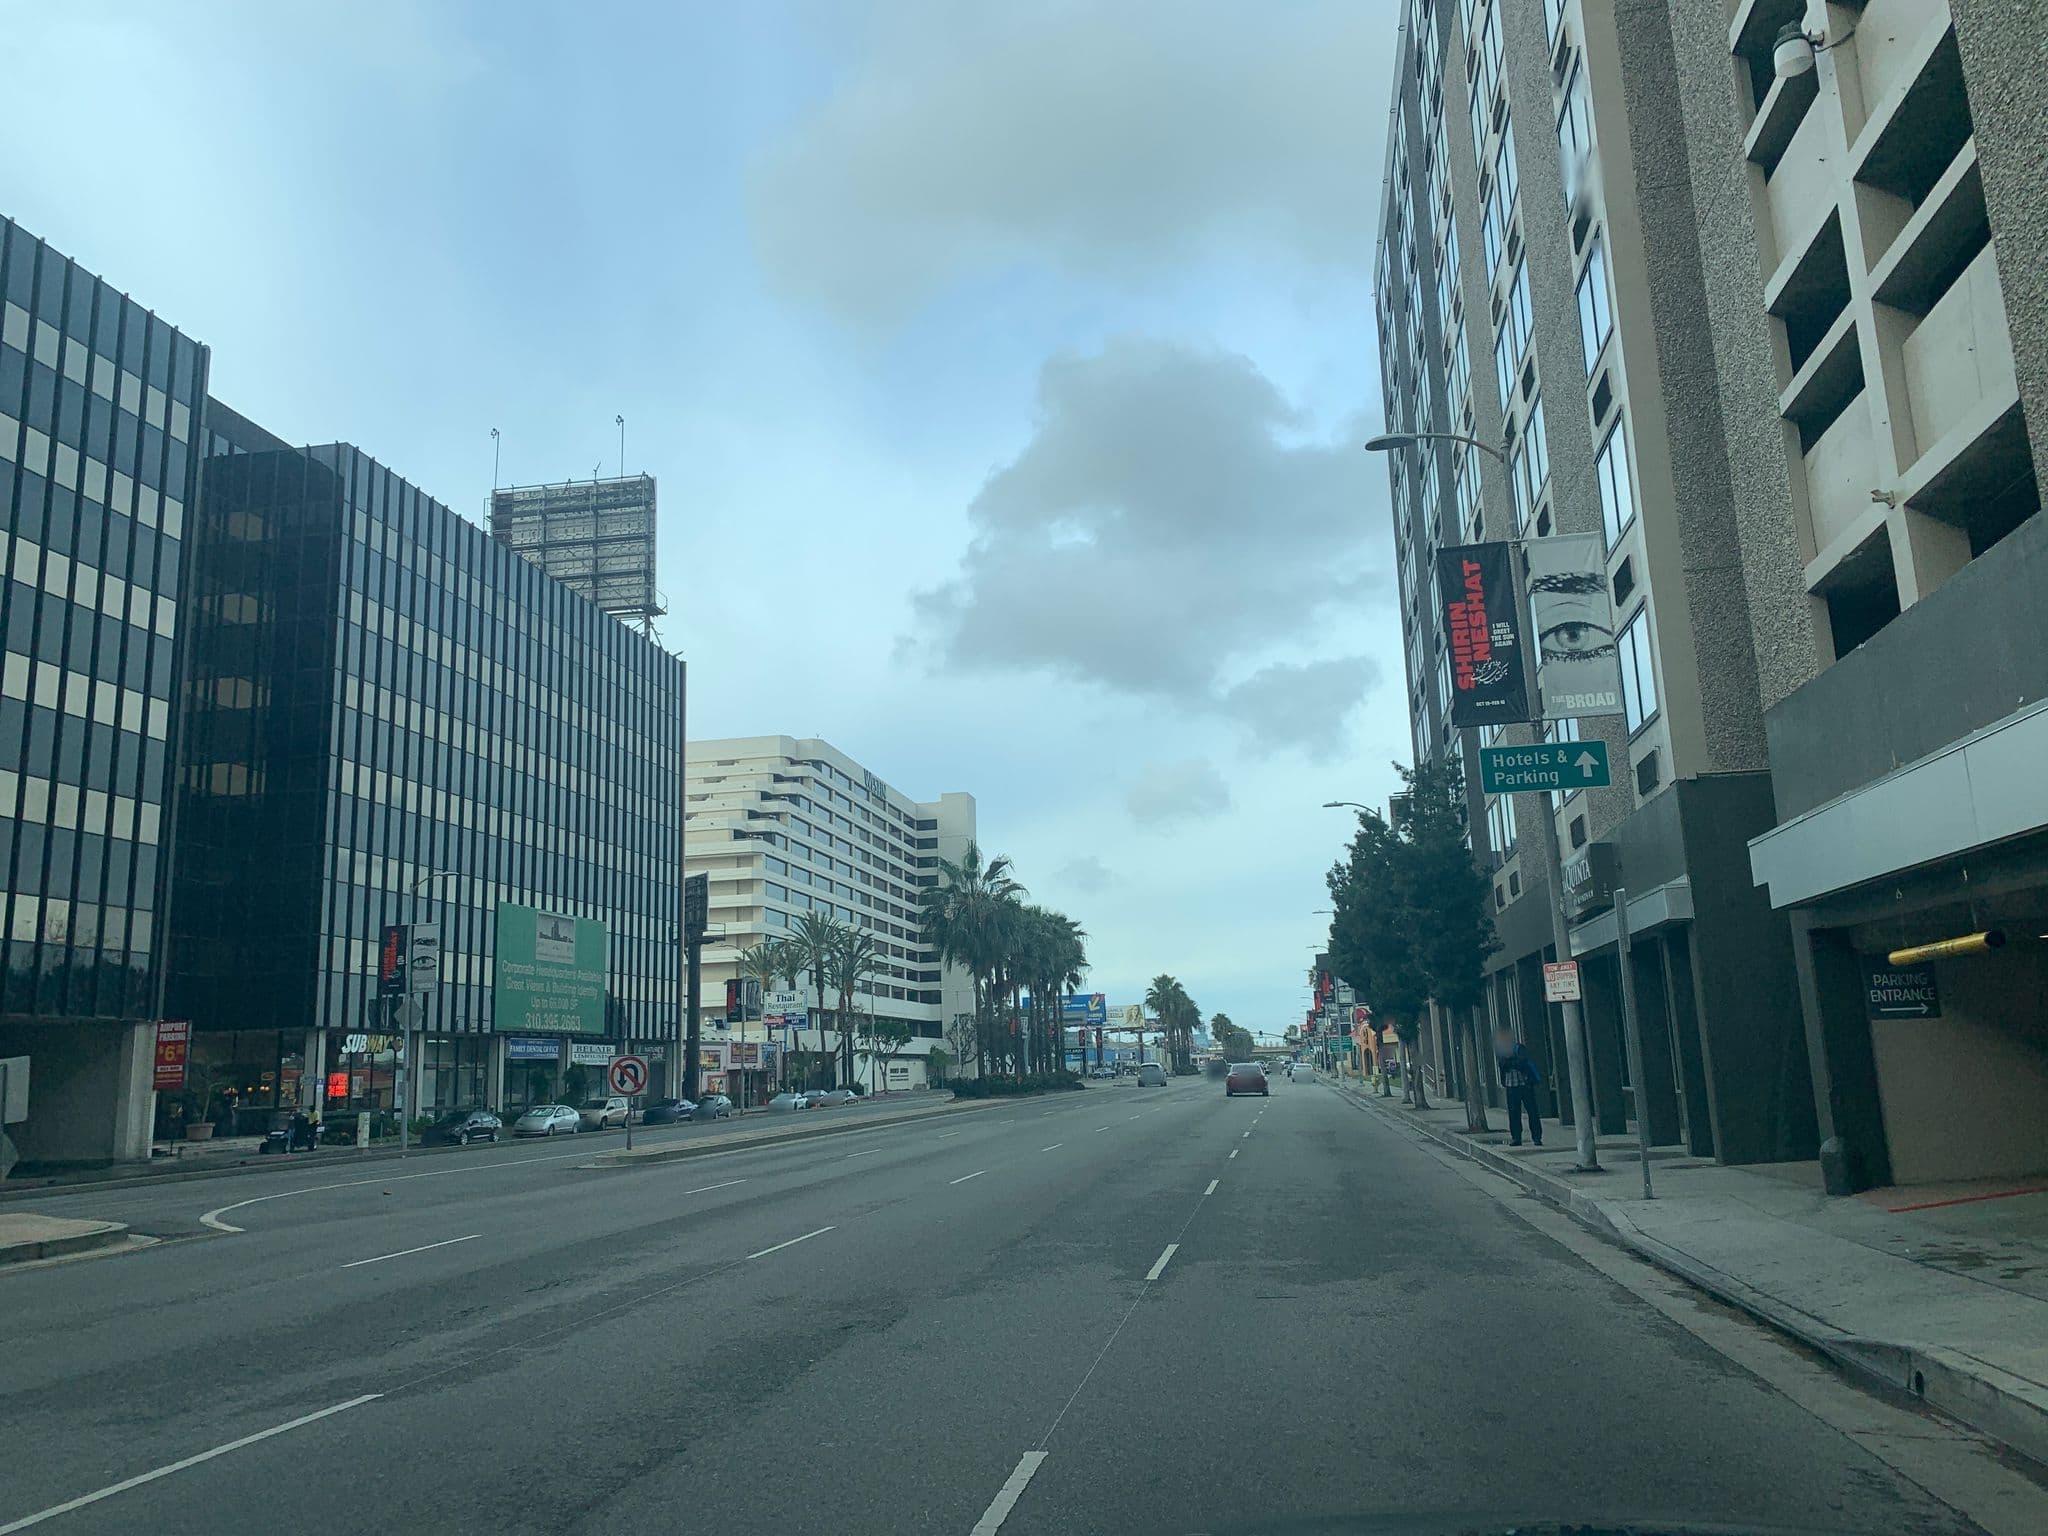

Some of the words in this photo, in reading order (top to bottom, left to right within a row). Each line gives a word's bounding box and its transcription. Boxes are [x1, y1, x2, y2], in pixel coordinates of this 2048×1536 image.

[1463, 559, 1491, 662] NESHAT
[1448, 601, 1477, 690] SHIRIN
[1566, 692, 1616, 709] BROAD
[1492, 751, 1550, 768] Hotels
[1557, 749, 1568, 763] &
[1494, 769, 1559, 786] Parking
[1872, 972, 1928, 987] PARKING
[775, 994, 796, 1002] Thai
[1870, 987, 1936, 1002] ENTRANCE
[341, 1033, 394, 1054] SUBWAY
